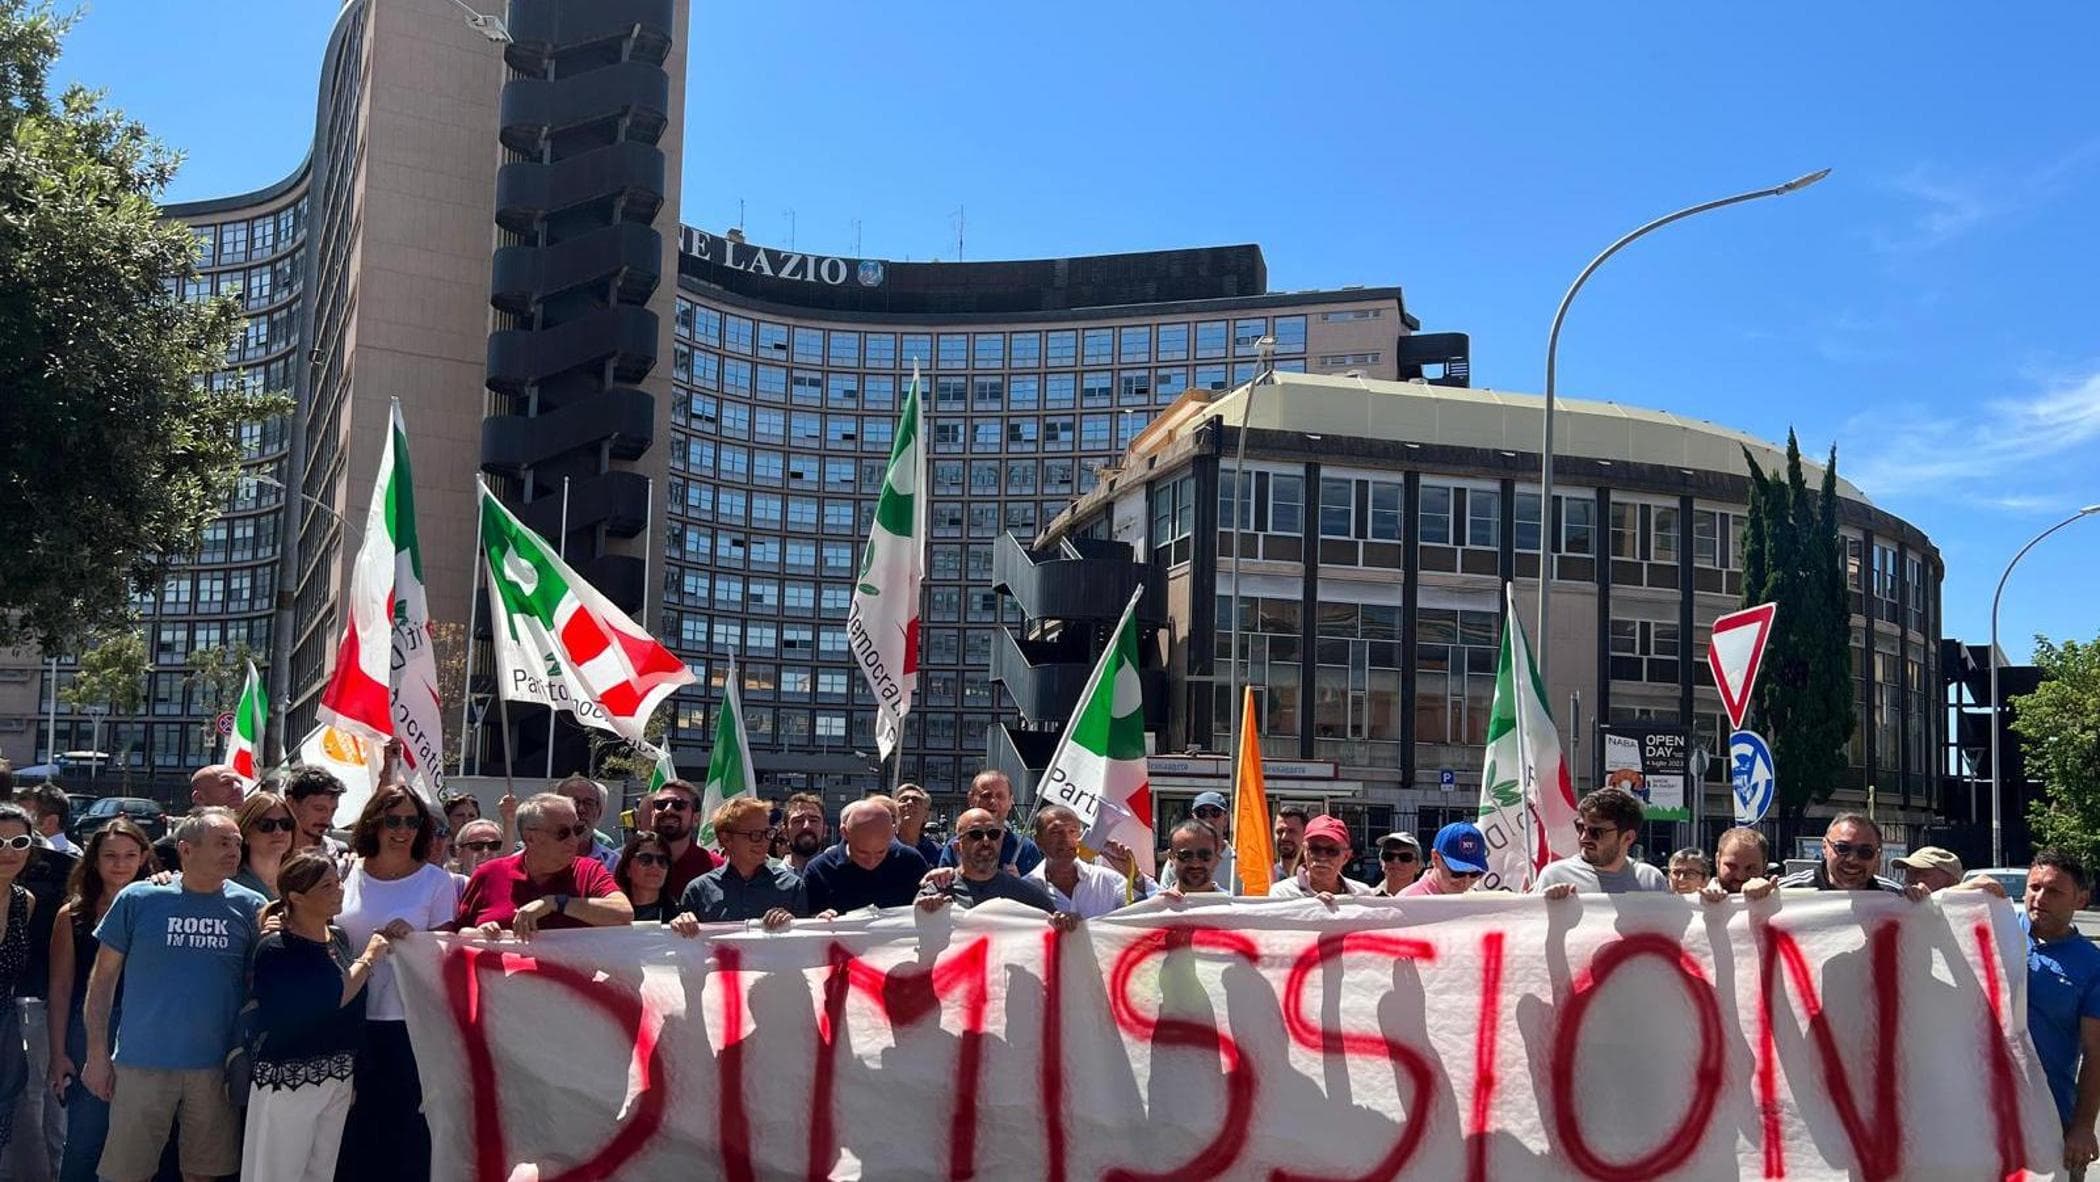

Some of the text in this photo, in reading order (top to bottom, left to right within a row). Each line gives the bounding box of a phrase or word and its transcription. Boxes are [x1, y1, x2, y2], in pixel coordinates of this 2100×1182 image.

[724, 240, 848, 285] LAZIO
[1646, 734, 1685, 747] OPEN
[1646, 746, 1673, 758] DAY
[1443, 773, 1452, 783] P
[167, 917, 229, 935] ROCK
[166, 933, 230, 949] IN IDRO
[441, 914, 2031, 1182] DIMISSIONI
